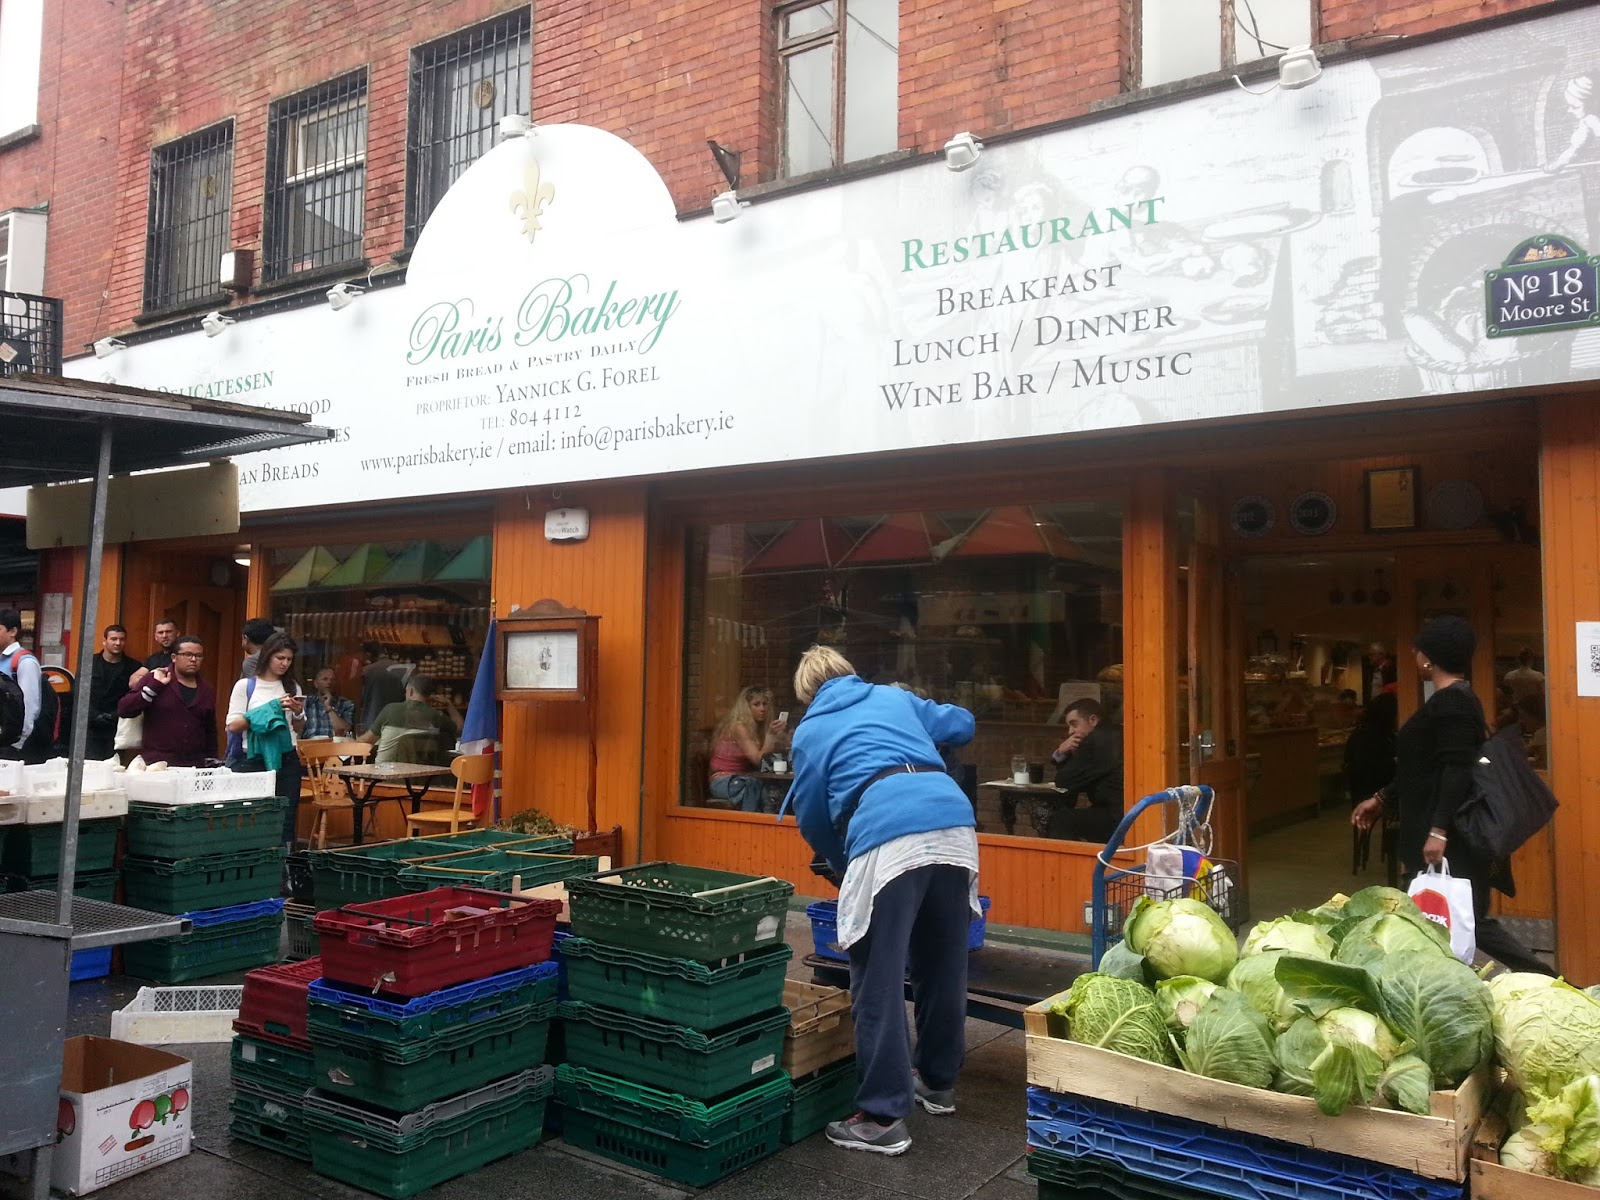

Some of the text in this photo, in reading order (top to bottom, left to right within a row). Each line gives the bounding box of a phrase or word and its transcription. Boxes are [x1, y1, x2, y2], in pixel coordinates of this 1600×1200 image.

[900, 196, 1166, 273] RESTAURANT
[935, 263, 1122, 317] BREAKFAST
[1548, 267, 1583, 298] 18
[405, 273, 683, 366] Paris Bakery
[892, 330, 1000, 368] LUNCH
[1034, 304, 1177, 347] DINNER
[1500, 297, 1591, 323] Moore St
[406, 340, 638, 388] FRESH BREAD & PASTRY DAILY
[415, 364, 661, 416] PROPRIETOR: YANNICK G. FOREL
[878, 380, 964, 411] WINE
[971, 370, 1039, 402] BAR
[1070, 351, 1194, 390] MUSIC
[360, 441, 493, 475] www.parisbakery.ie
[508, 431, 556, 457] email:
[560, 411, 735, 451] info@parisbakery.ie
[480, 404, 583, 431] TEL: 804 4112
[261, 462, 320, 484] BREADS
